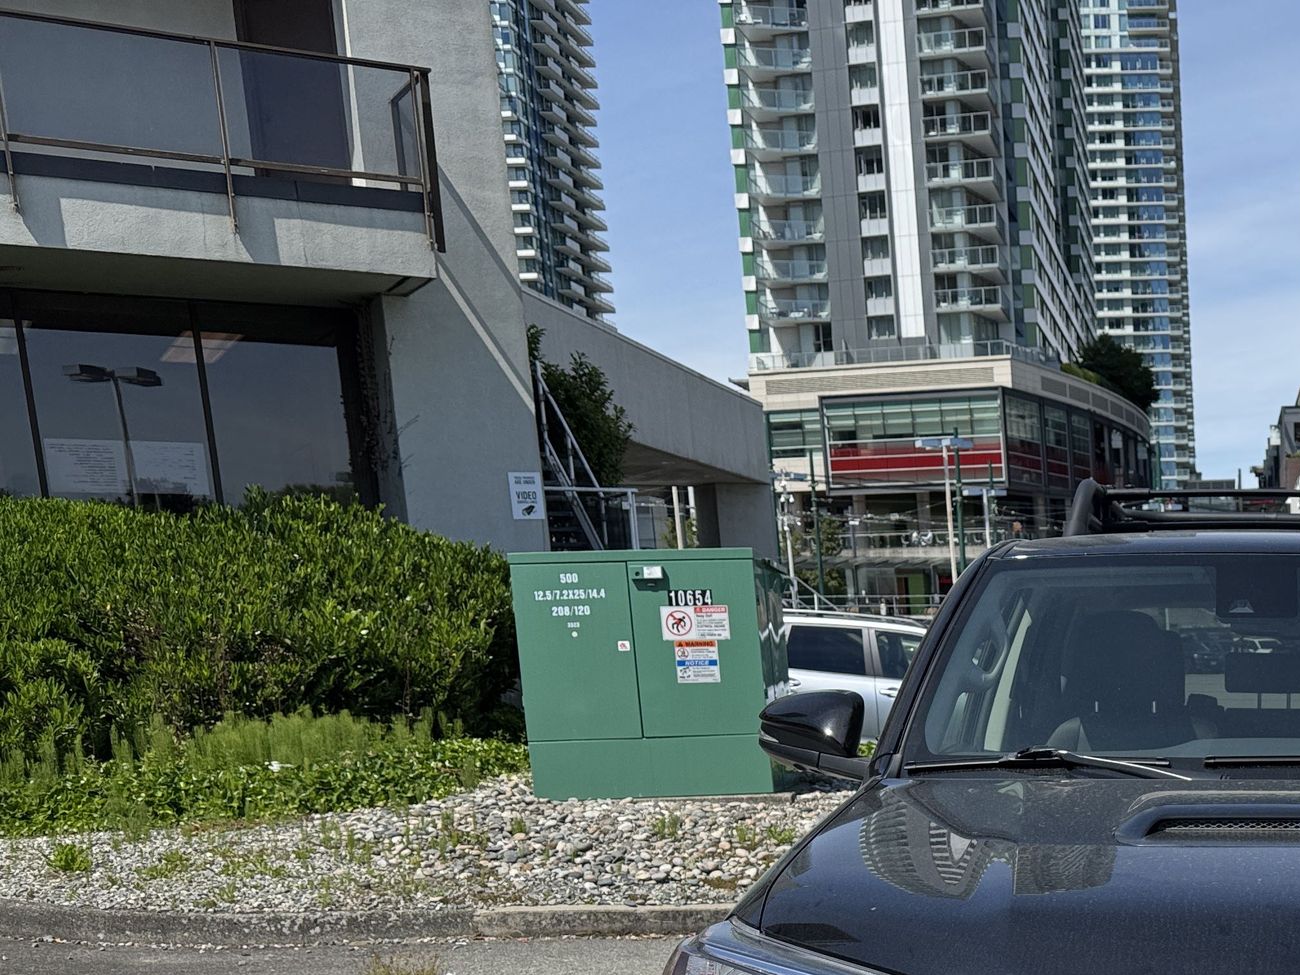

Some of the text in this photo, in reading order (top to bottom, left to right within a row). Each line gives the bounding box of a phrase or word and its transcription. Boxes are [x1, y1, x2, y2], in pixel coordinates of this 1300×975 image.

[515, 490, 537, 500] VIDEO
[559, 573, 578, 583] 500
[534, 588, 606, 601] 12.5/7.2X25/14.4
[669, 589, 712, 606] 10654
[551, 605, 591, 616] 208/120
